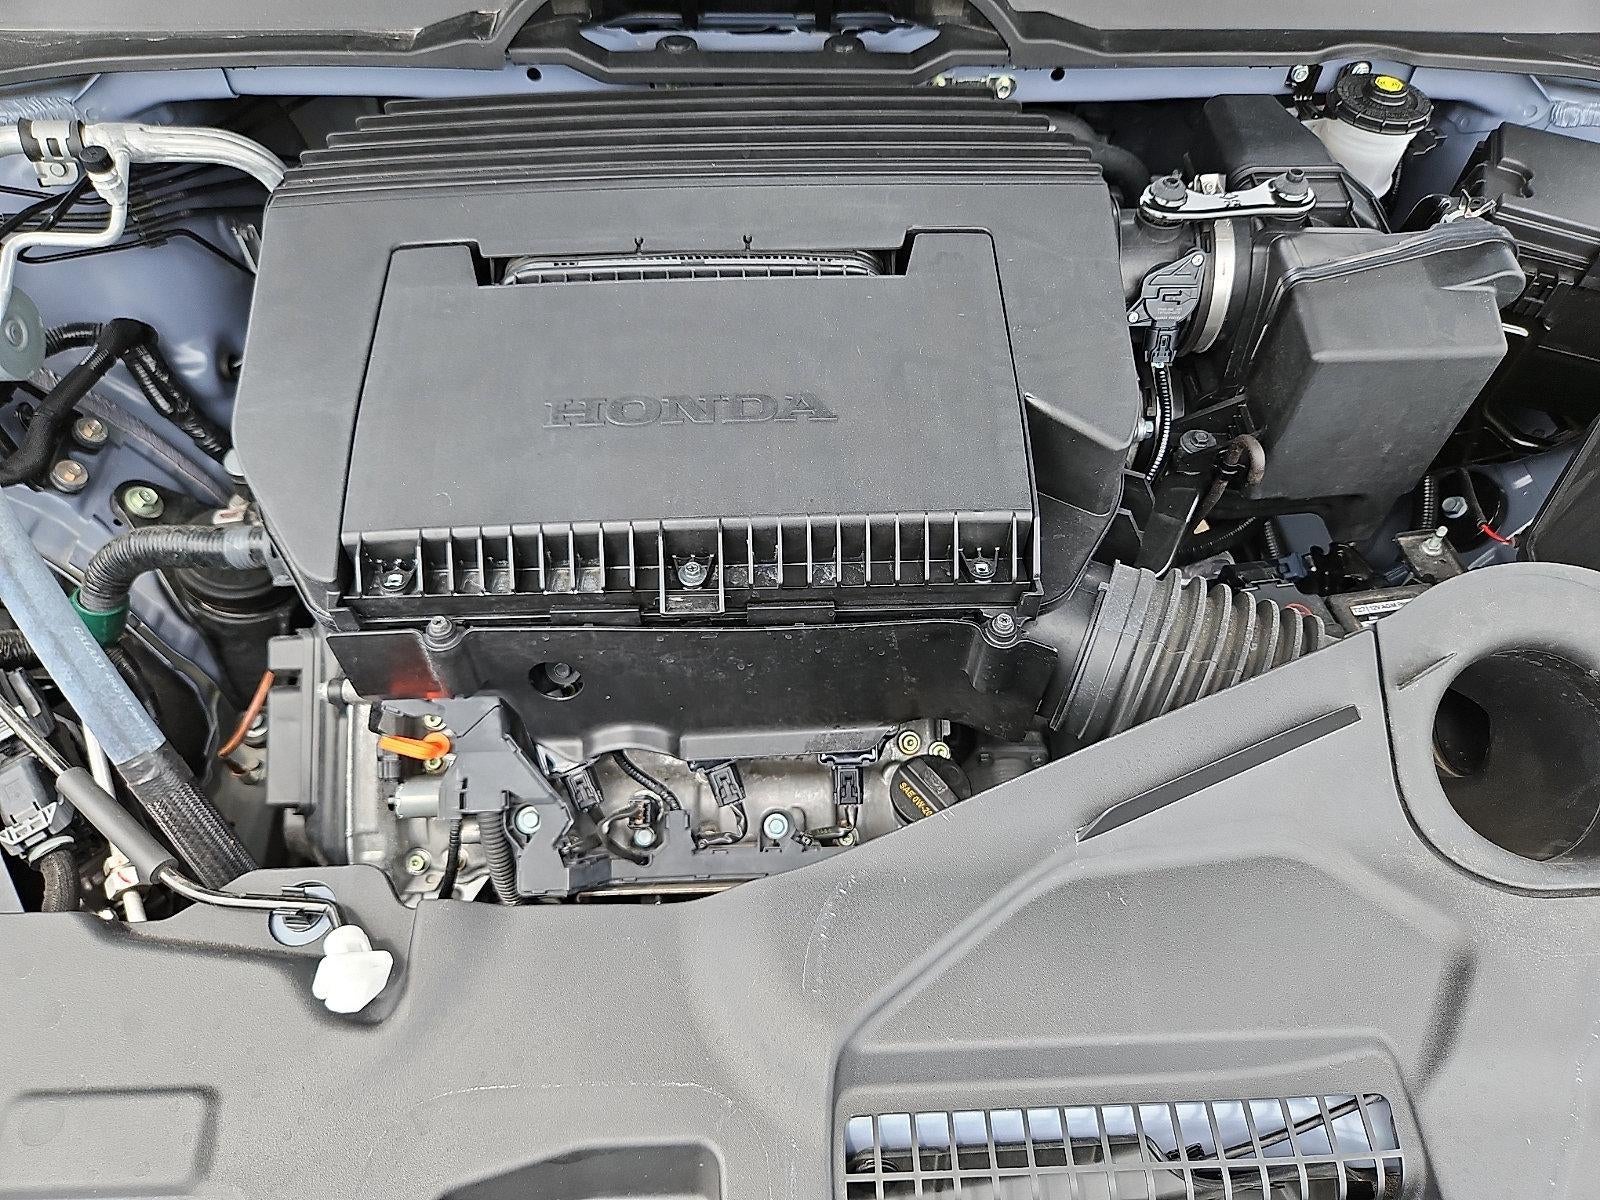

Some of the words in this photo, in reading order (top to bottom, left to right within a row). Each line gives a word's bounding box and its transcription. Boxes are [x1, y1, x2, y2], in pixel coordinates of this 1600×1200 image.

[543, 394, 838, 427] HONDA
[899, 782, 917, 799] SAE
[912, 796, 933, 817] 0W-20
